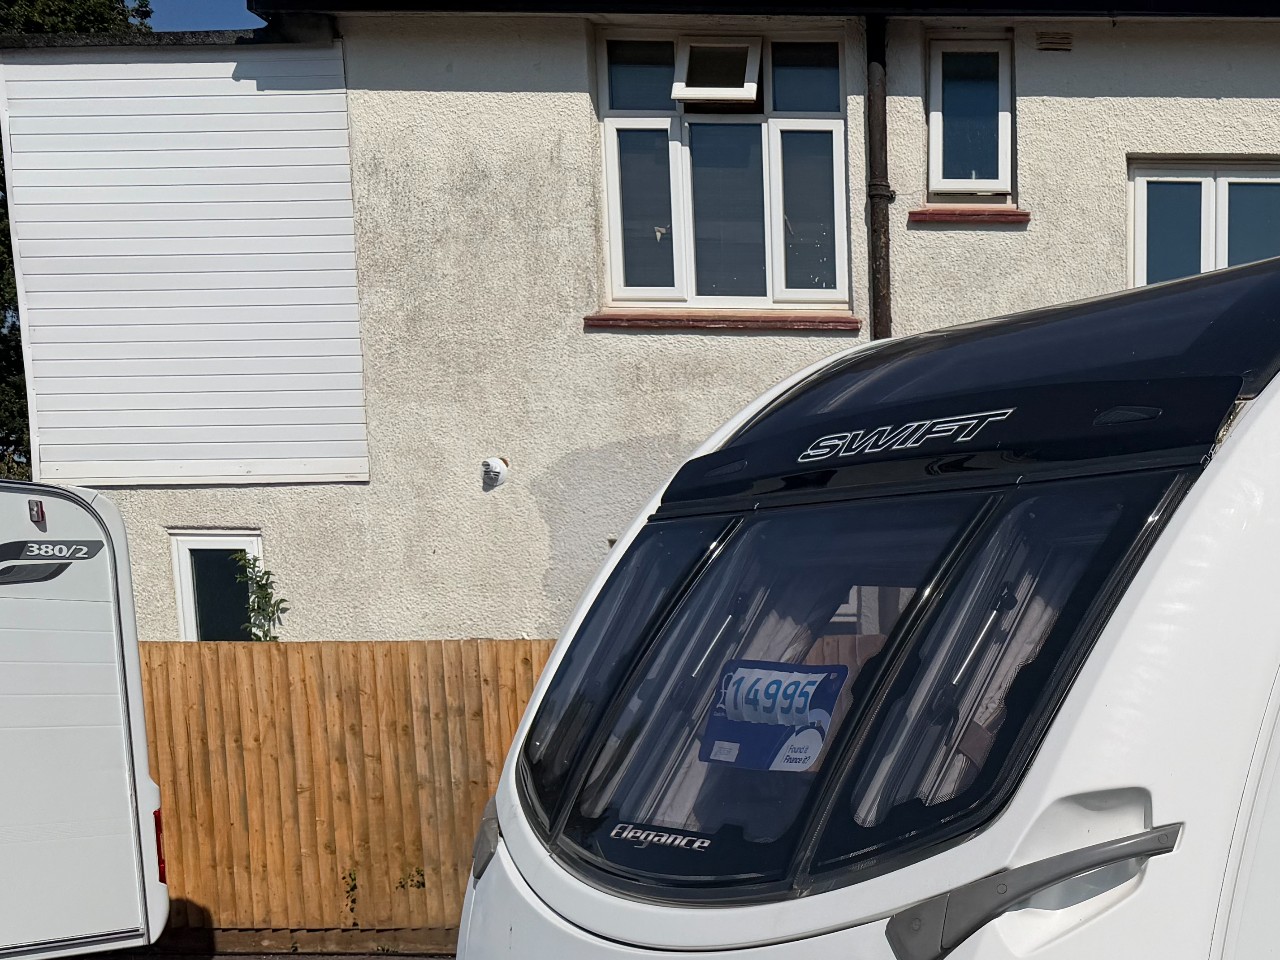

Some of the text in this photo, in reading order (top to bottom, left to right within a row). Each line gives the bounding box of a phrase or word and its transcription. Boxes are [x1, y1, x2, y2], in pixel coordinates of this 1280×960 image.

[797, 407, 1018, 463] SWIFT
[26, 543, 89, 558] 380/2
[609, 823, 712, 852] Elegance
